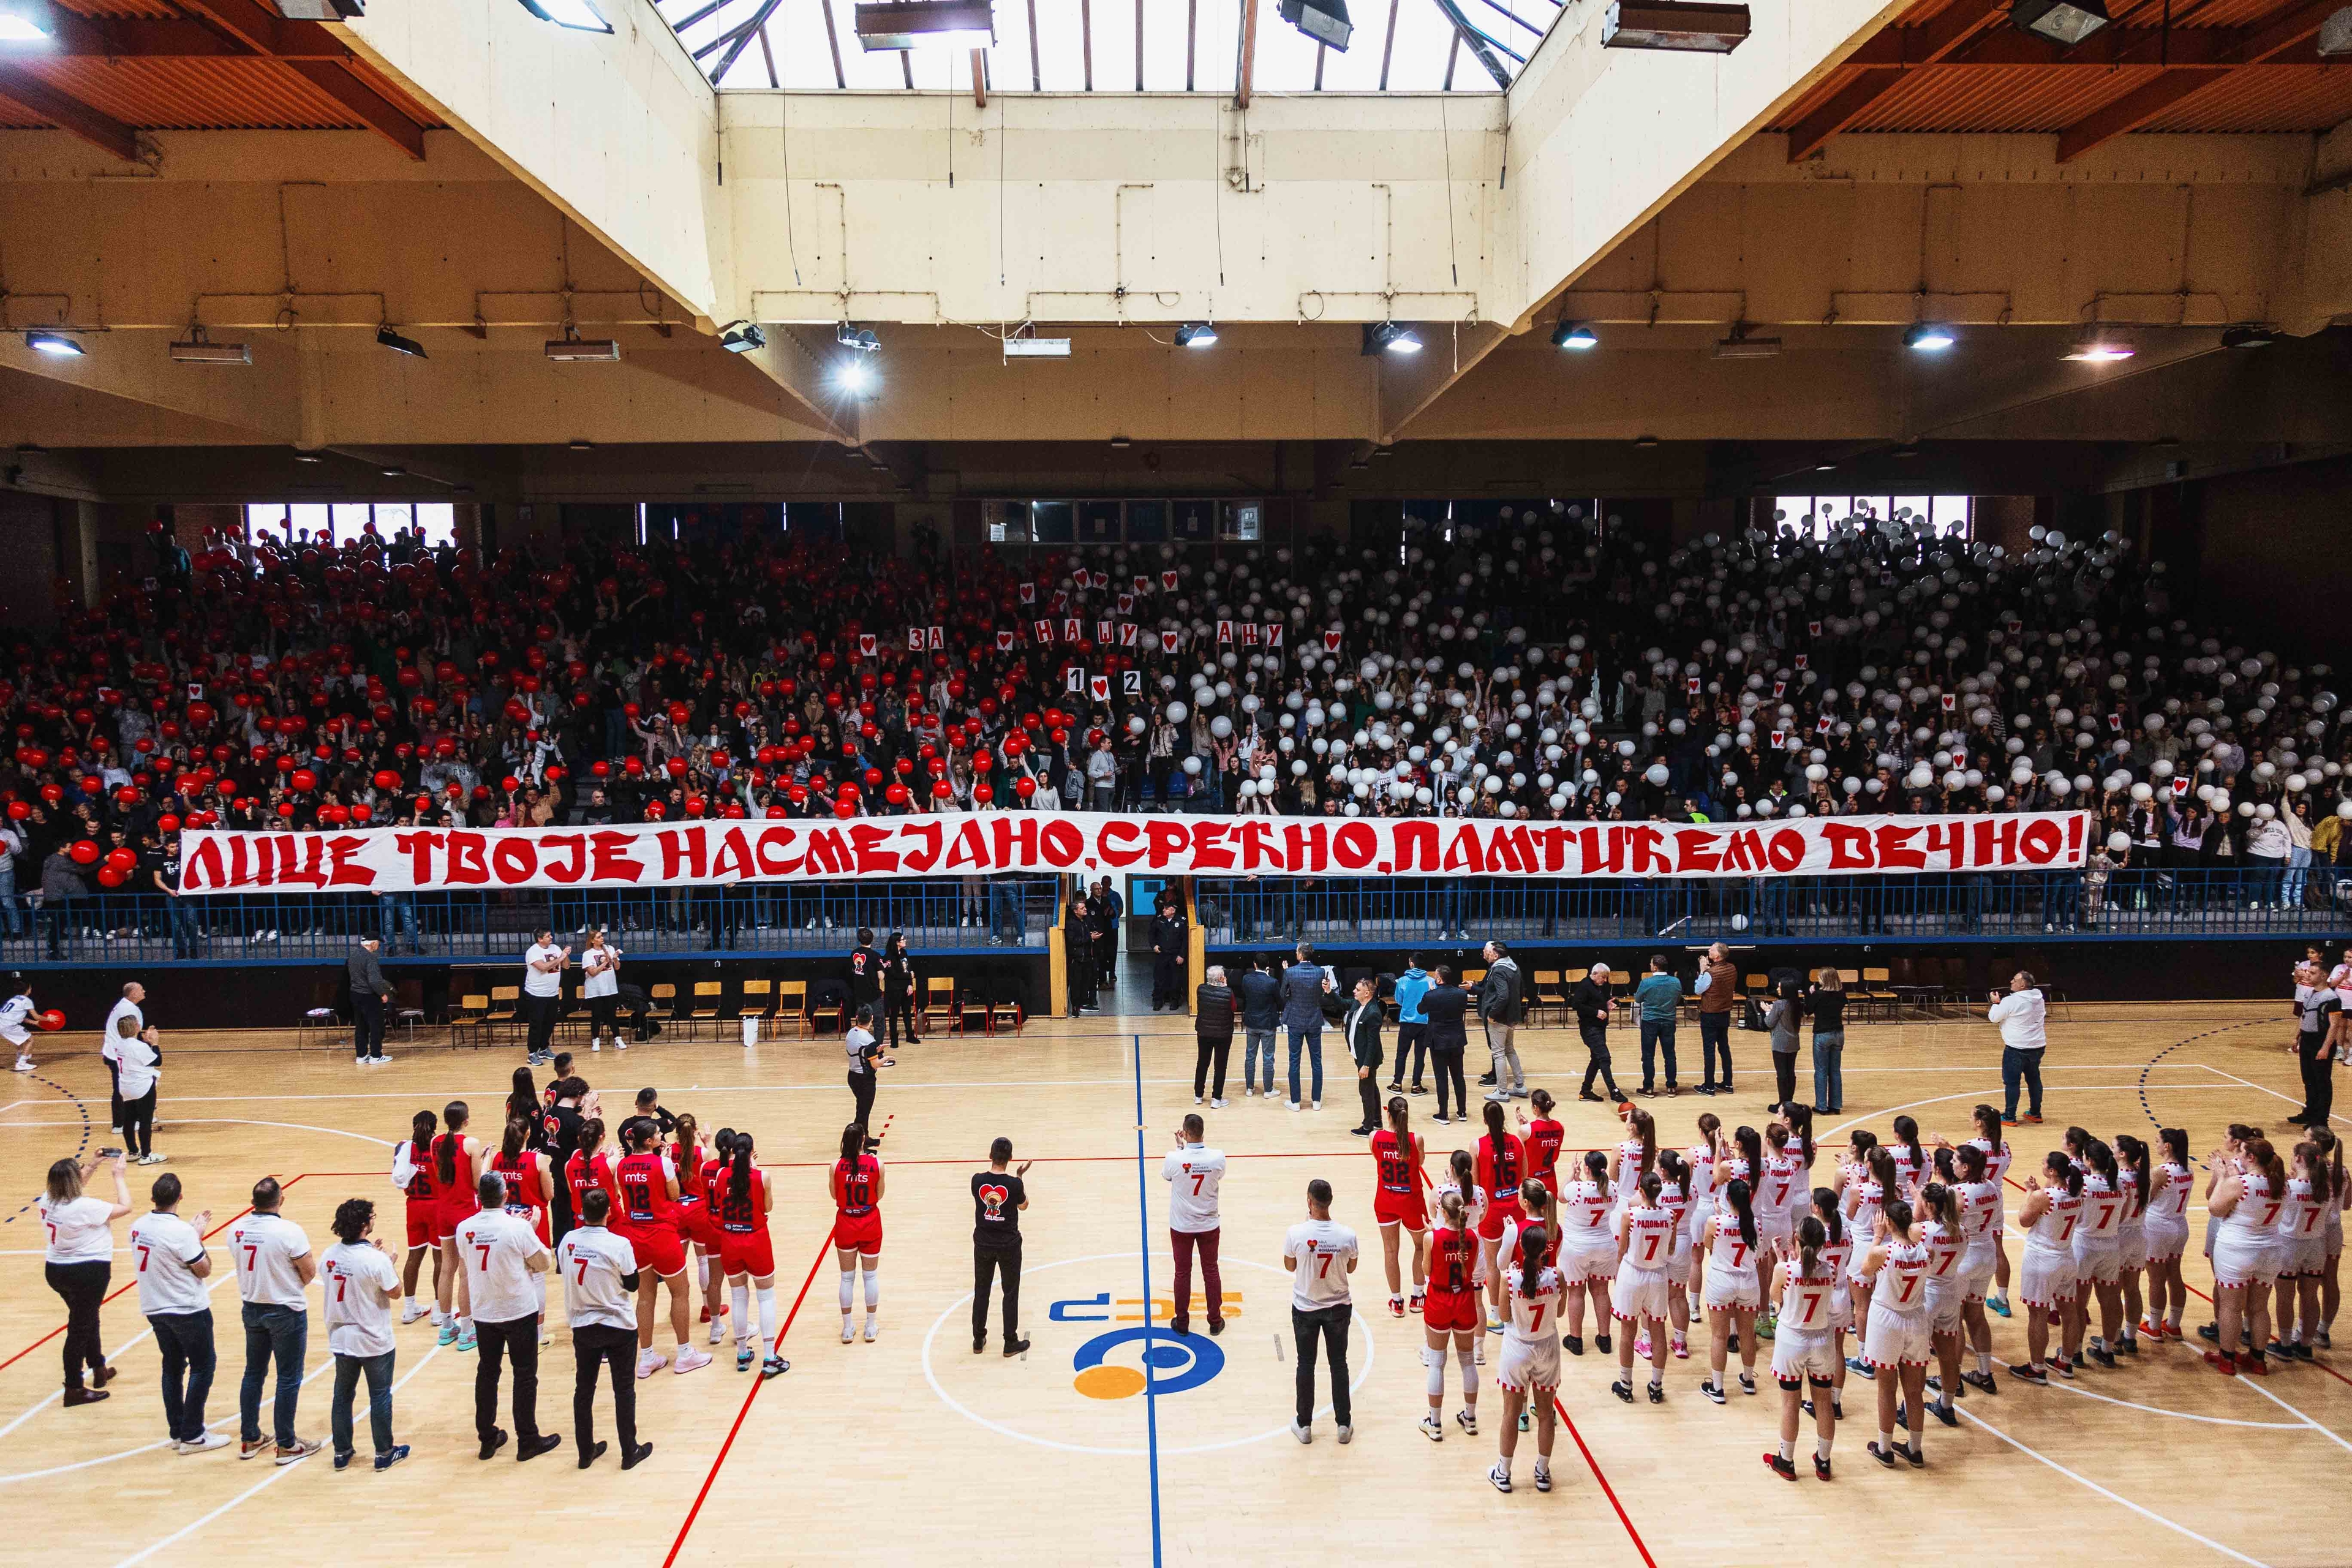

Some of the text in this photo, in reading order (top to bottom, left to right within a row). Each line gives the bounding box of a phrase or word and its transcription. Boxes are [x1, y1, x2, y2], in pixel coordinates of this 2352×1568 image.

[1069, 669, 1138, 693] 1 2
[184, 835, 375, 889] ЛИЦЕ
[395, 830, 643, 884] ТВОЈЕ
[1393, 821, 1805, 873] ПАМТИЋЕМО
[1822, 815, 2084, 869] ВЕЧНО!
[1383, 1150, 1401, 1159] mt
[1541, 1138, 1559, 1147] mts
[503, 1170, 522, 1180] mts
[622, 1162, 652, 1171] POTTER
[625, 1172, 647, 1183] mts
[846, 1173, 869, 1183] mts
[1381, 1160, 1411, 1183] 32
[1905, 1170, 1921, 1186] 7
[1986, 1163, 2000, 1181] 7
[625, 1185, 650, 1209] 12
[845, 1183, 869, 1207] 10
[1191, 1174, 1205, 1197] 7
[1774, 1183, 1790, 1207] 7
[723, 1197, 753, 1221] 22
[2176, 1188, 2188, 1213] 7
[1589, 1208, 1605, 1227] 7
[1637, 1219, 1669, 1229] РАДОЊИЋ
[1980, 1208, 1994, 1233] 7
[2097, 1204, 2116, 1230] 7
[2262, 1203, 2281, 1226] 7
[2304, 1207, 2321, 1232] 7
[47, 1223, 56, 1245] 7
[2059, 1215, 2077, 1241] 7
[137, 1245, 151, 1272] 7
[243, 1245, 257, 1272] 7
[475, 1244, 490, 1272] 7
[1446, 1251, 1469, 1262] mts
[1644, 1234, 1661, 1262] 7
[1731, 1243, 1748, 1268] 7
[573, 1257, 589, 1286] 7
[1316, 1253, 1334, 1280] 7
[1894, 1259, 1928, 1270] РАДОЊИЋ
[1936, 1251, 1958, 1276] 7
[333, 1275, 347, 1303] 7
[1899, 1275, 1918, 1303] 7
[1528, 1303, 1547, 1333] 7
[1803, 1293, 1822, 1324] 7
